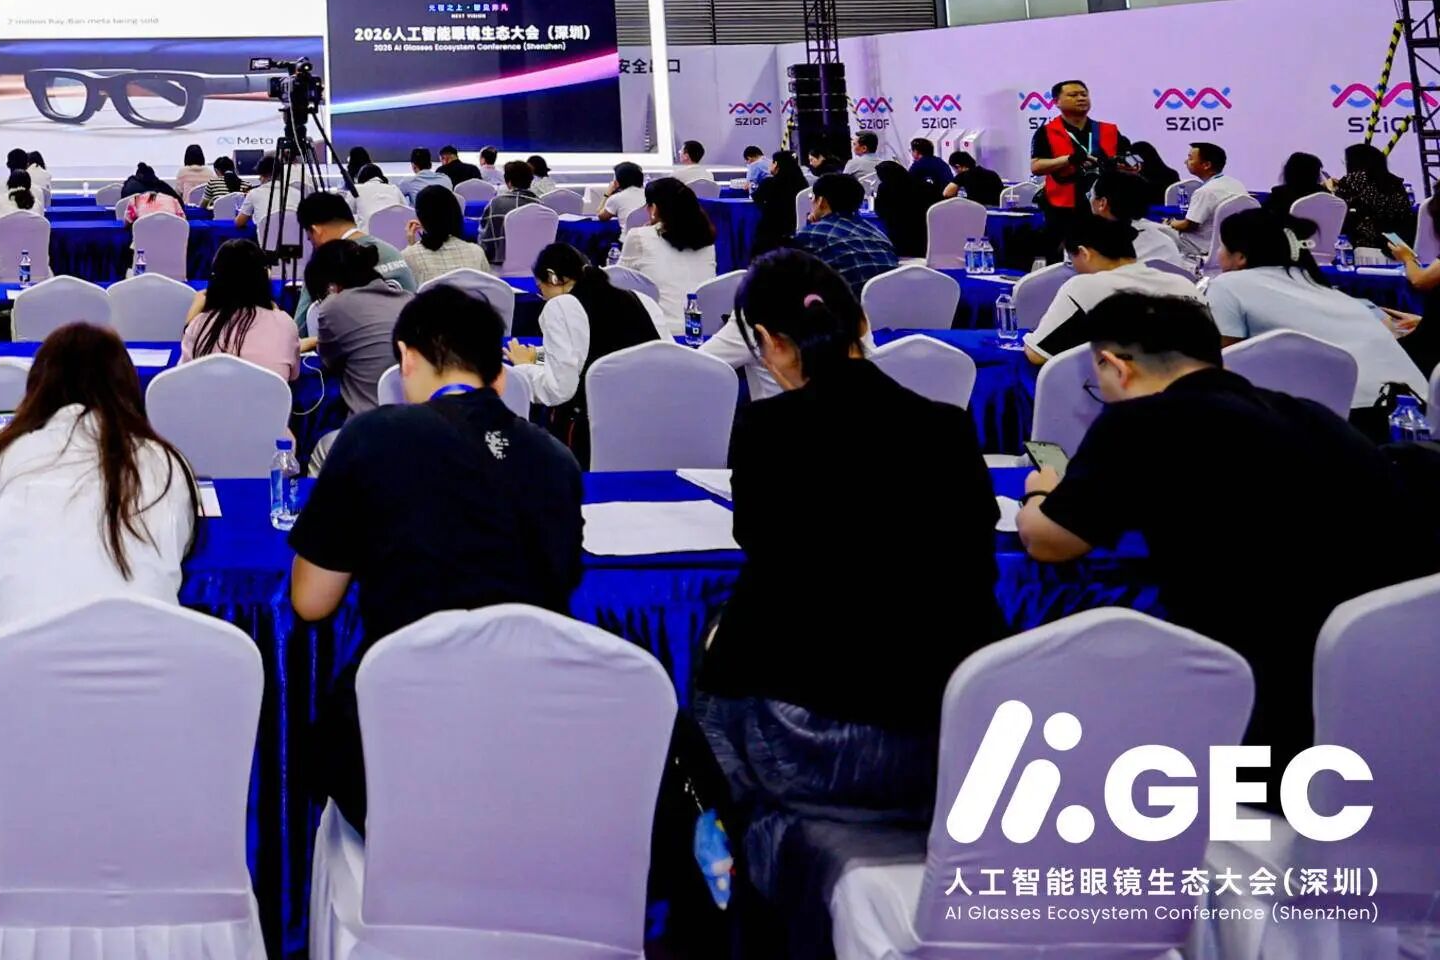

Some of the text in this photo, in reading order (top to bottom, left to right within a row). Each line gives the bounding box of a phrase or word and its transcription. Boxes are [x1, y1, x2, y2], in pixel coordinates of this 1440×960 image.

[403, 43, 433, 51] Glasses
[434, 43, 476, 52] Ecosystem
[476, 43, 522, 51] Conference
[522, 42, 566, 52] (Shenzhen)
[618, 58, 681, 74] 安全口
[735, 117, 768, 126] SZiOF
[921, 117, 957, 129] SZiOF
[1166, 117, 1224, 132] SZiOF
[237, 136, 274, 145] Meta
